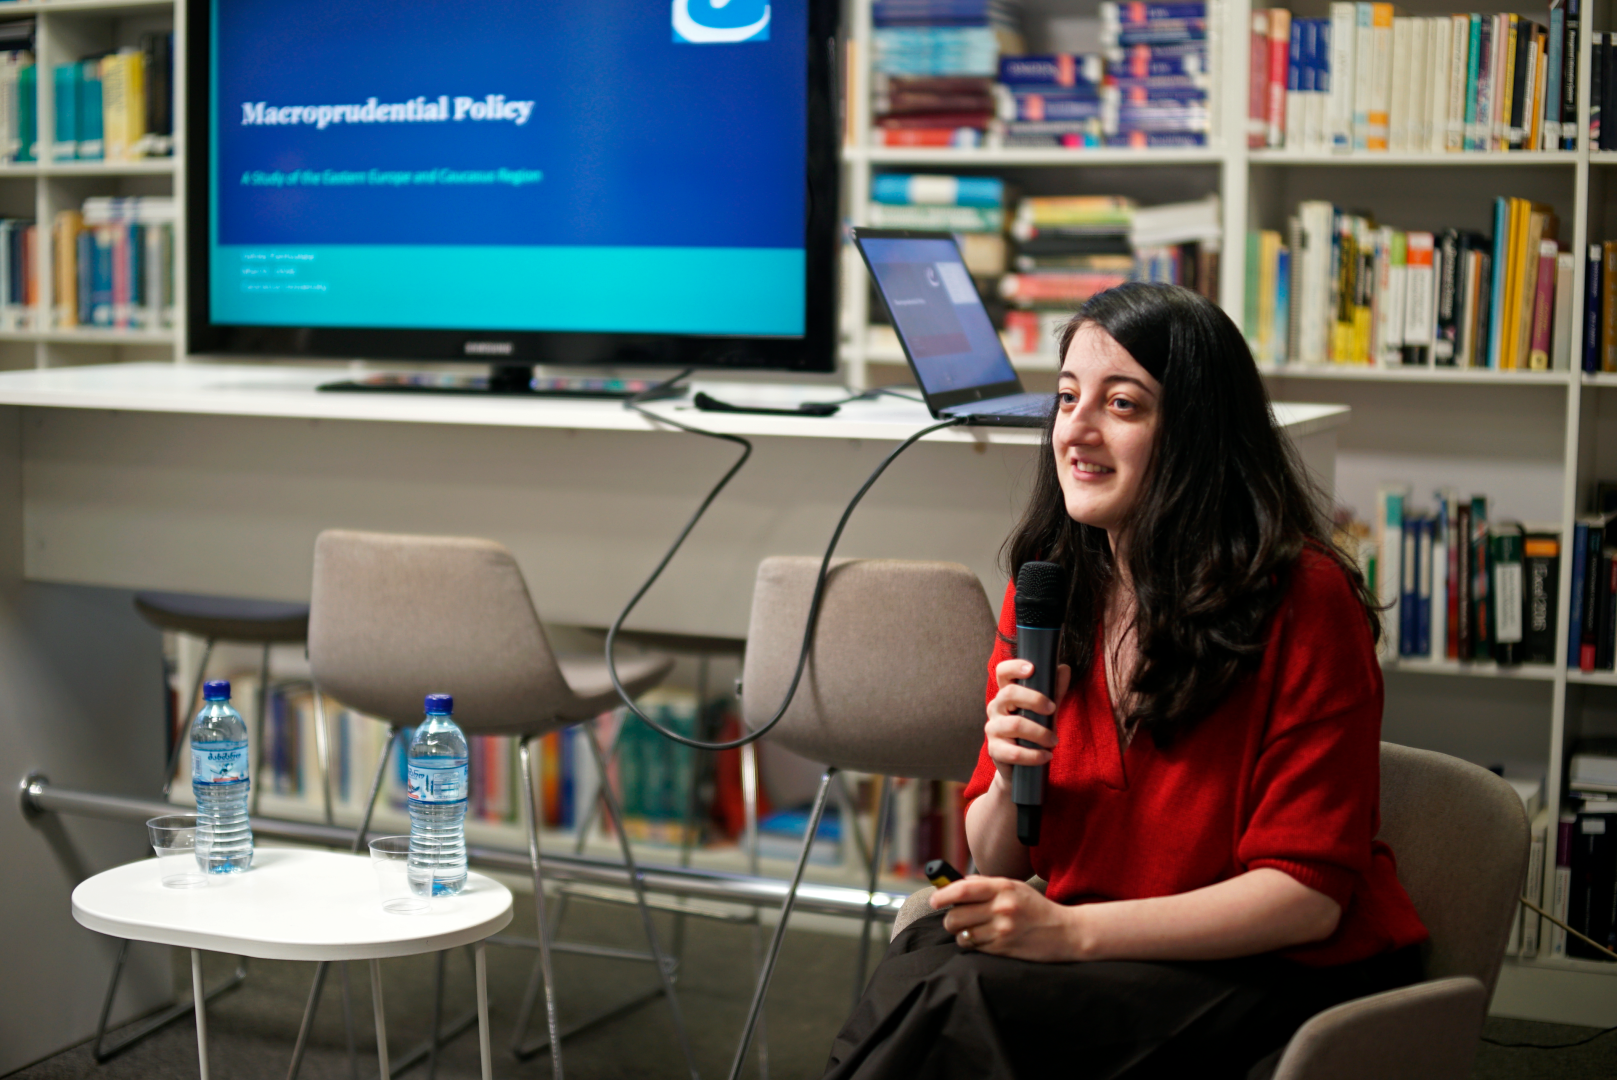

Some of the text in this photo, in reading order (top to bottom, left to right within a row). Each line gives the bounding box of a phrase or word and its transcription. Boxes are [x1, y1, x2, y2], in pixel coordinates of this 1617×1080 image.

[241, 93, 535, 130] Macroprudential Policy
[251, 169, 284, 188] Study
[322, 168, 366, 186] Eastern
[367, 167, 411, 187] Europe
[413, 167, 438, 185] and
[438, 167, 496, 185] Caucasus
[498, 166, 544, 187] Region
